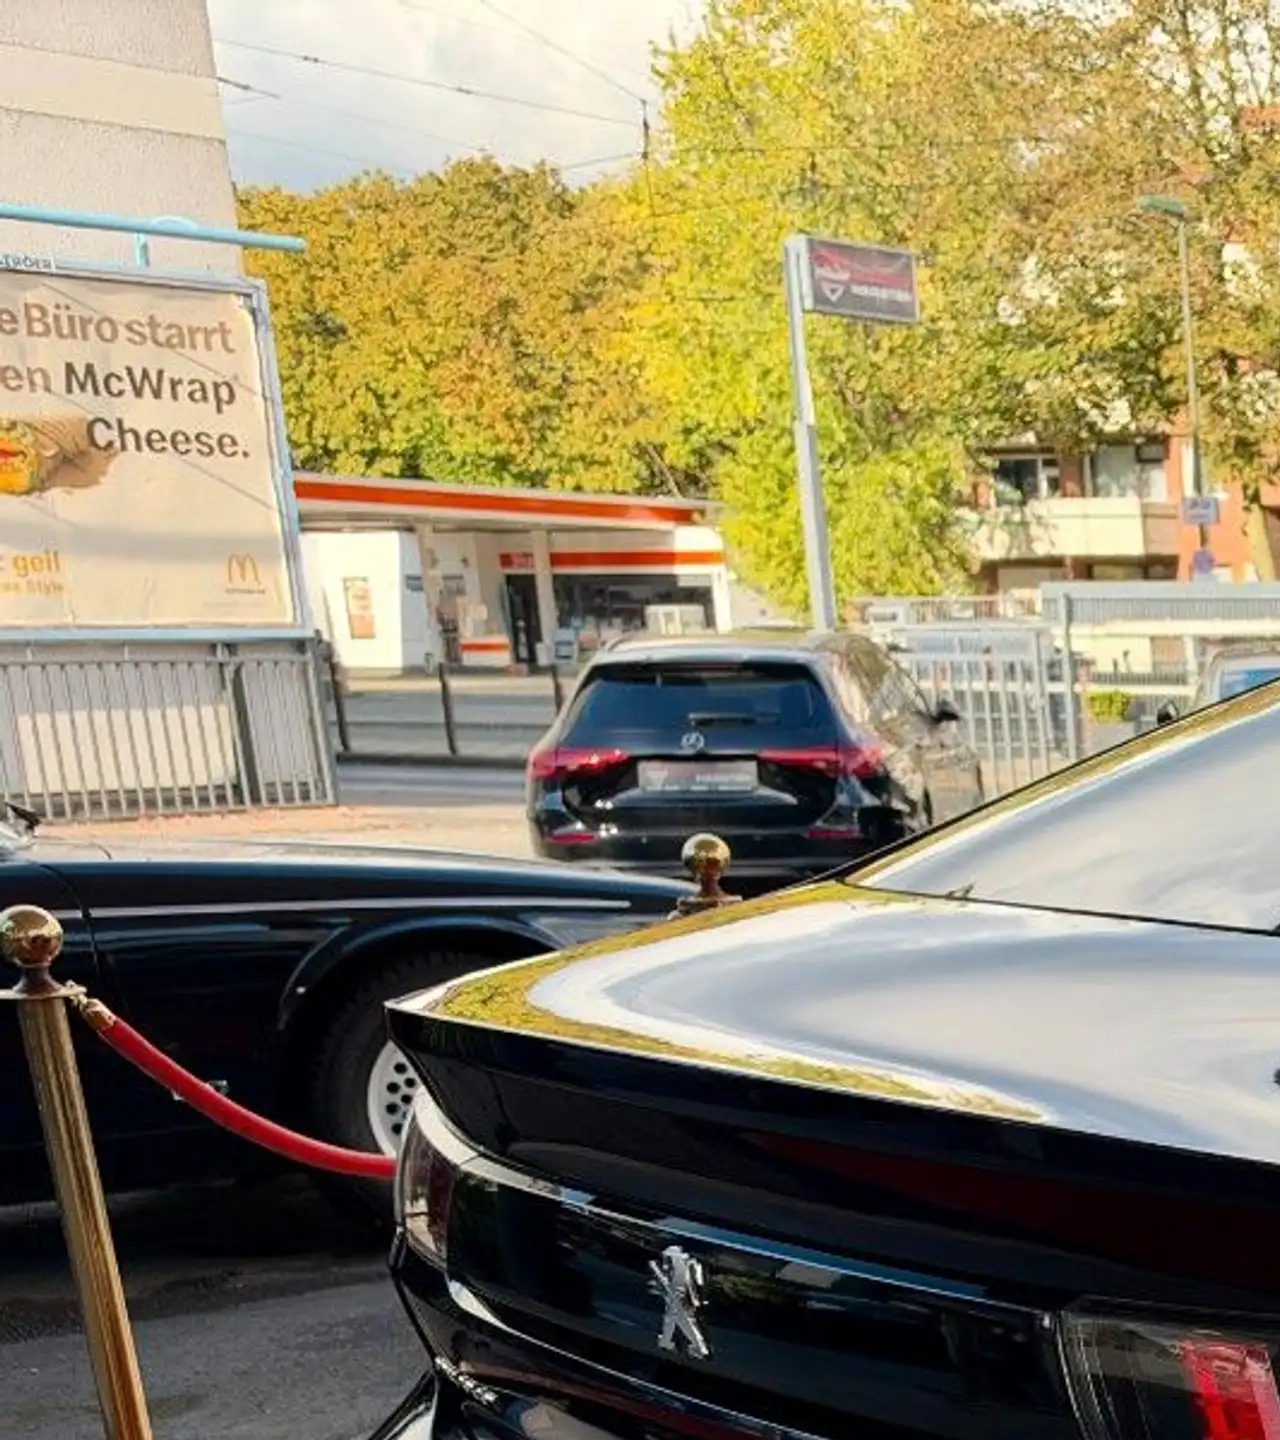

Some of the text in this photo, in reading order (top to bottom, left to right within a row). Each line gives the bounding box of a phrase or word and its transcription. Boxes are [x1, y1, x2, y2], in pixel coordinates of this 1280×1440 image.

[24, 302, 119, 343] Büro
[124, 315, 236, 354] starrt
[64, 361, 236, 414] McWrap
[87, 417, 250, 459] Cheese.
